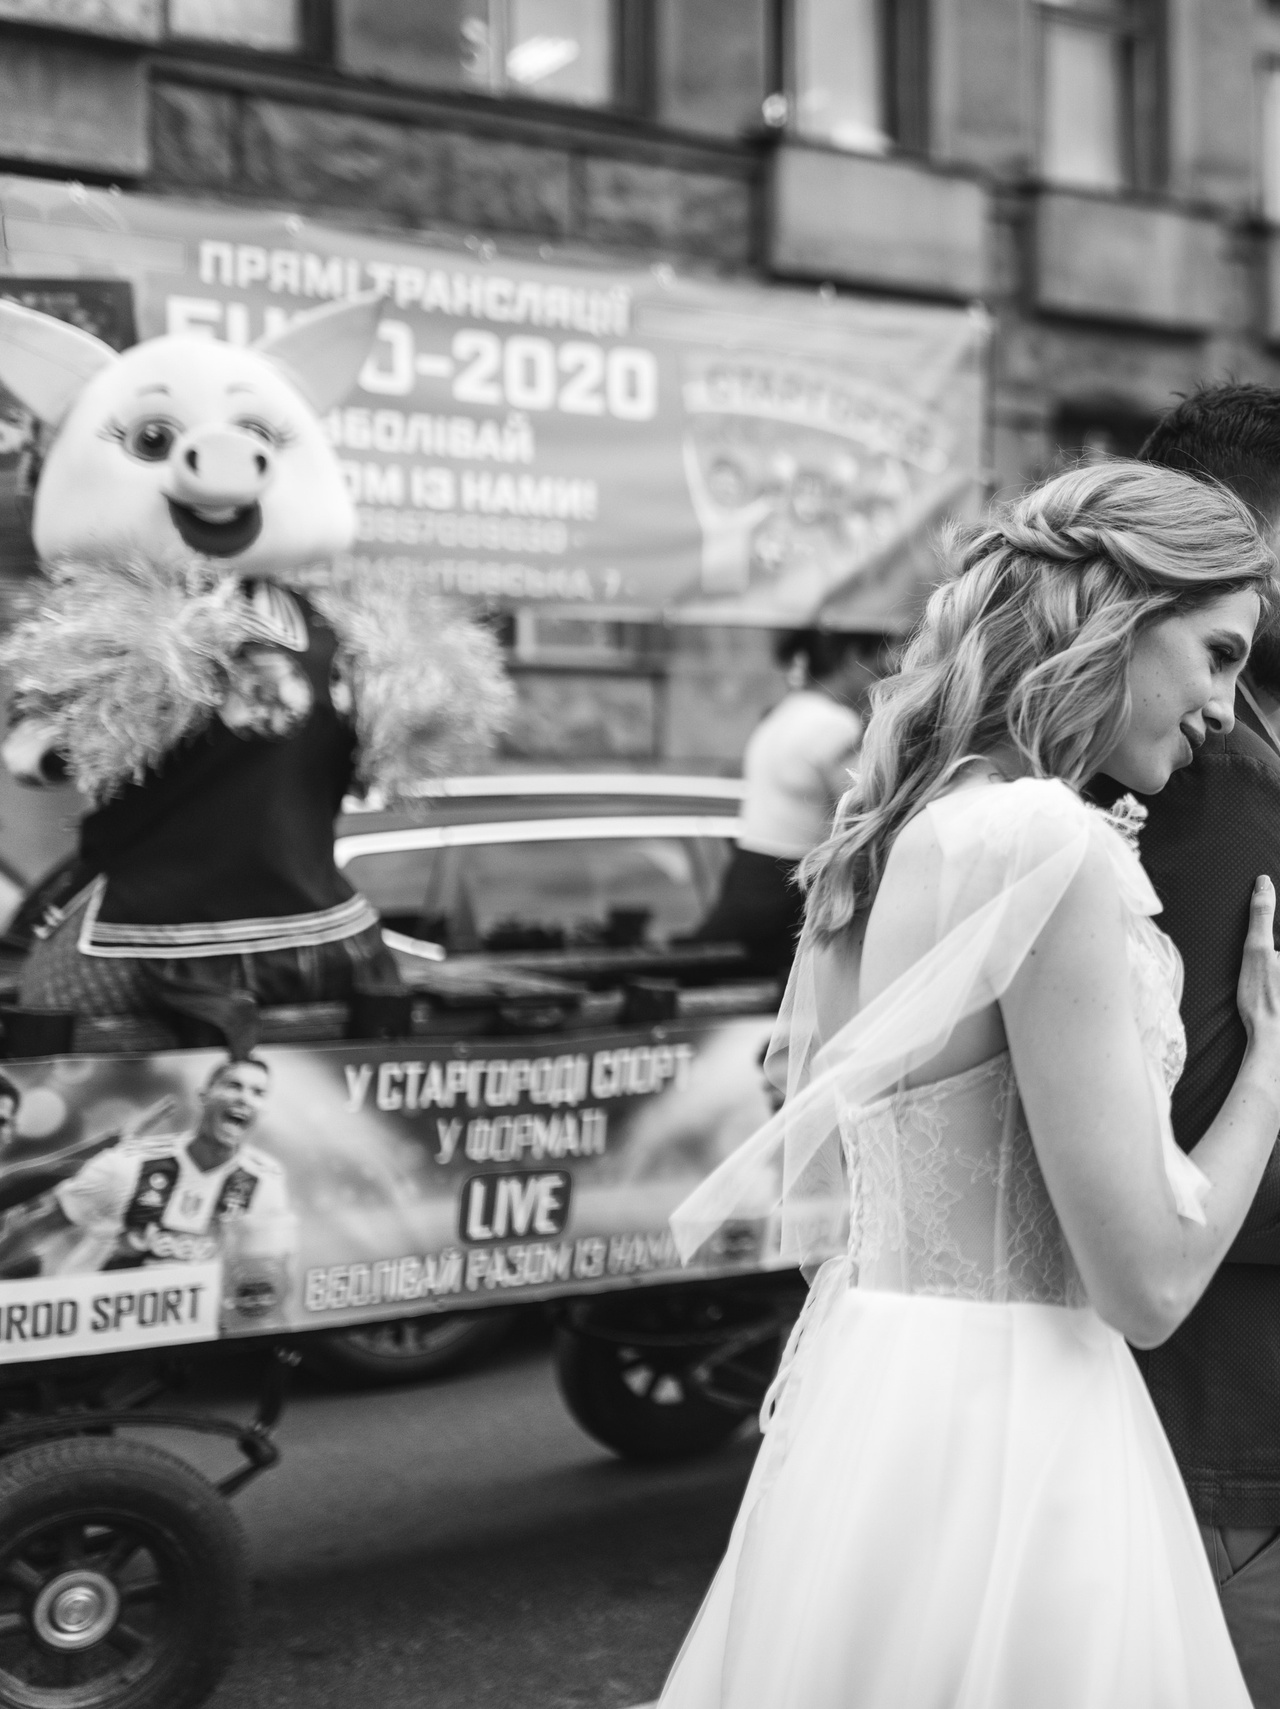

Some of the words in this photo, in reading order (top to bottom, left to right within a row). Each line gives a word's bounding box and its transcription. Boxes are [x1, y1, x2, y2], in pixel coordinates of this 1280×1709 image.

[200, 239, 359, 301] ПРЯМІ
[344, 1062, 373, 1113] У
[375, 1052, 590, 1112] СТАРГОРОДІ
[591, 1043, 692, 1100] СПОРТ
[433, 1115, 463, 1164] У
[465, 1107, 607, 1162] ФОРМАТІ
[467, 1173, 565, 1240] LIVE
[304, 1247, 463, 1312] ВБОЛІВАЙ
[466, 1240, 573, 1292] РАЗОМ
[0, 1300, 78, 1343] ROD
[91, 1283, 206, 1332] SPORT
